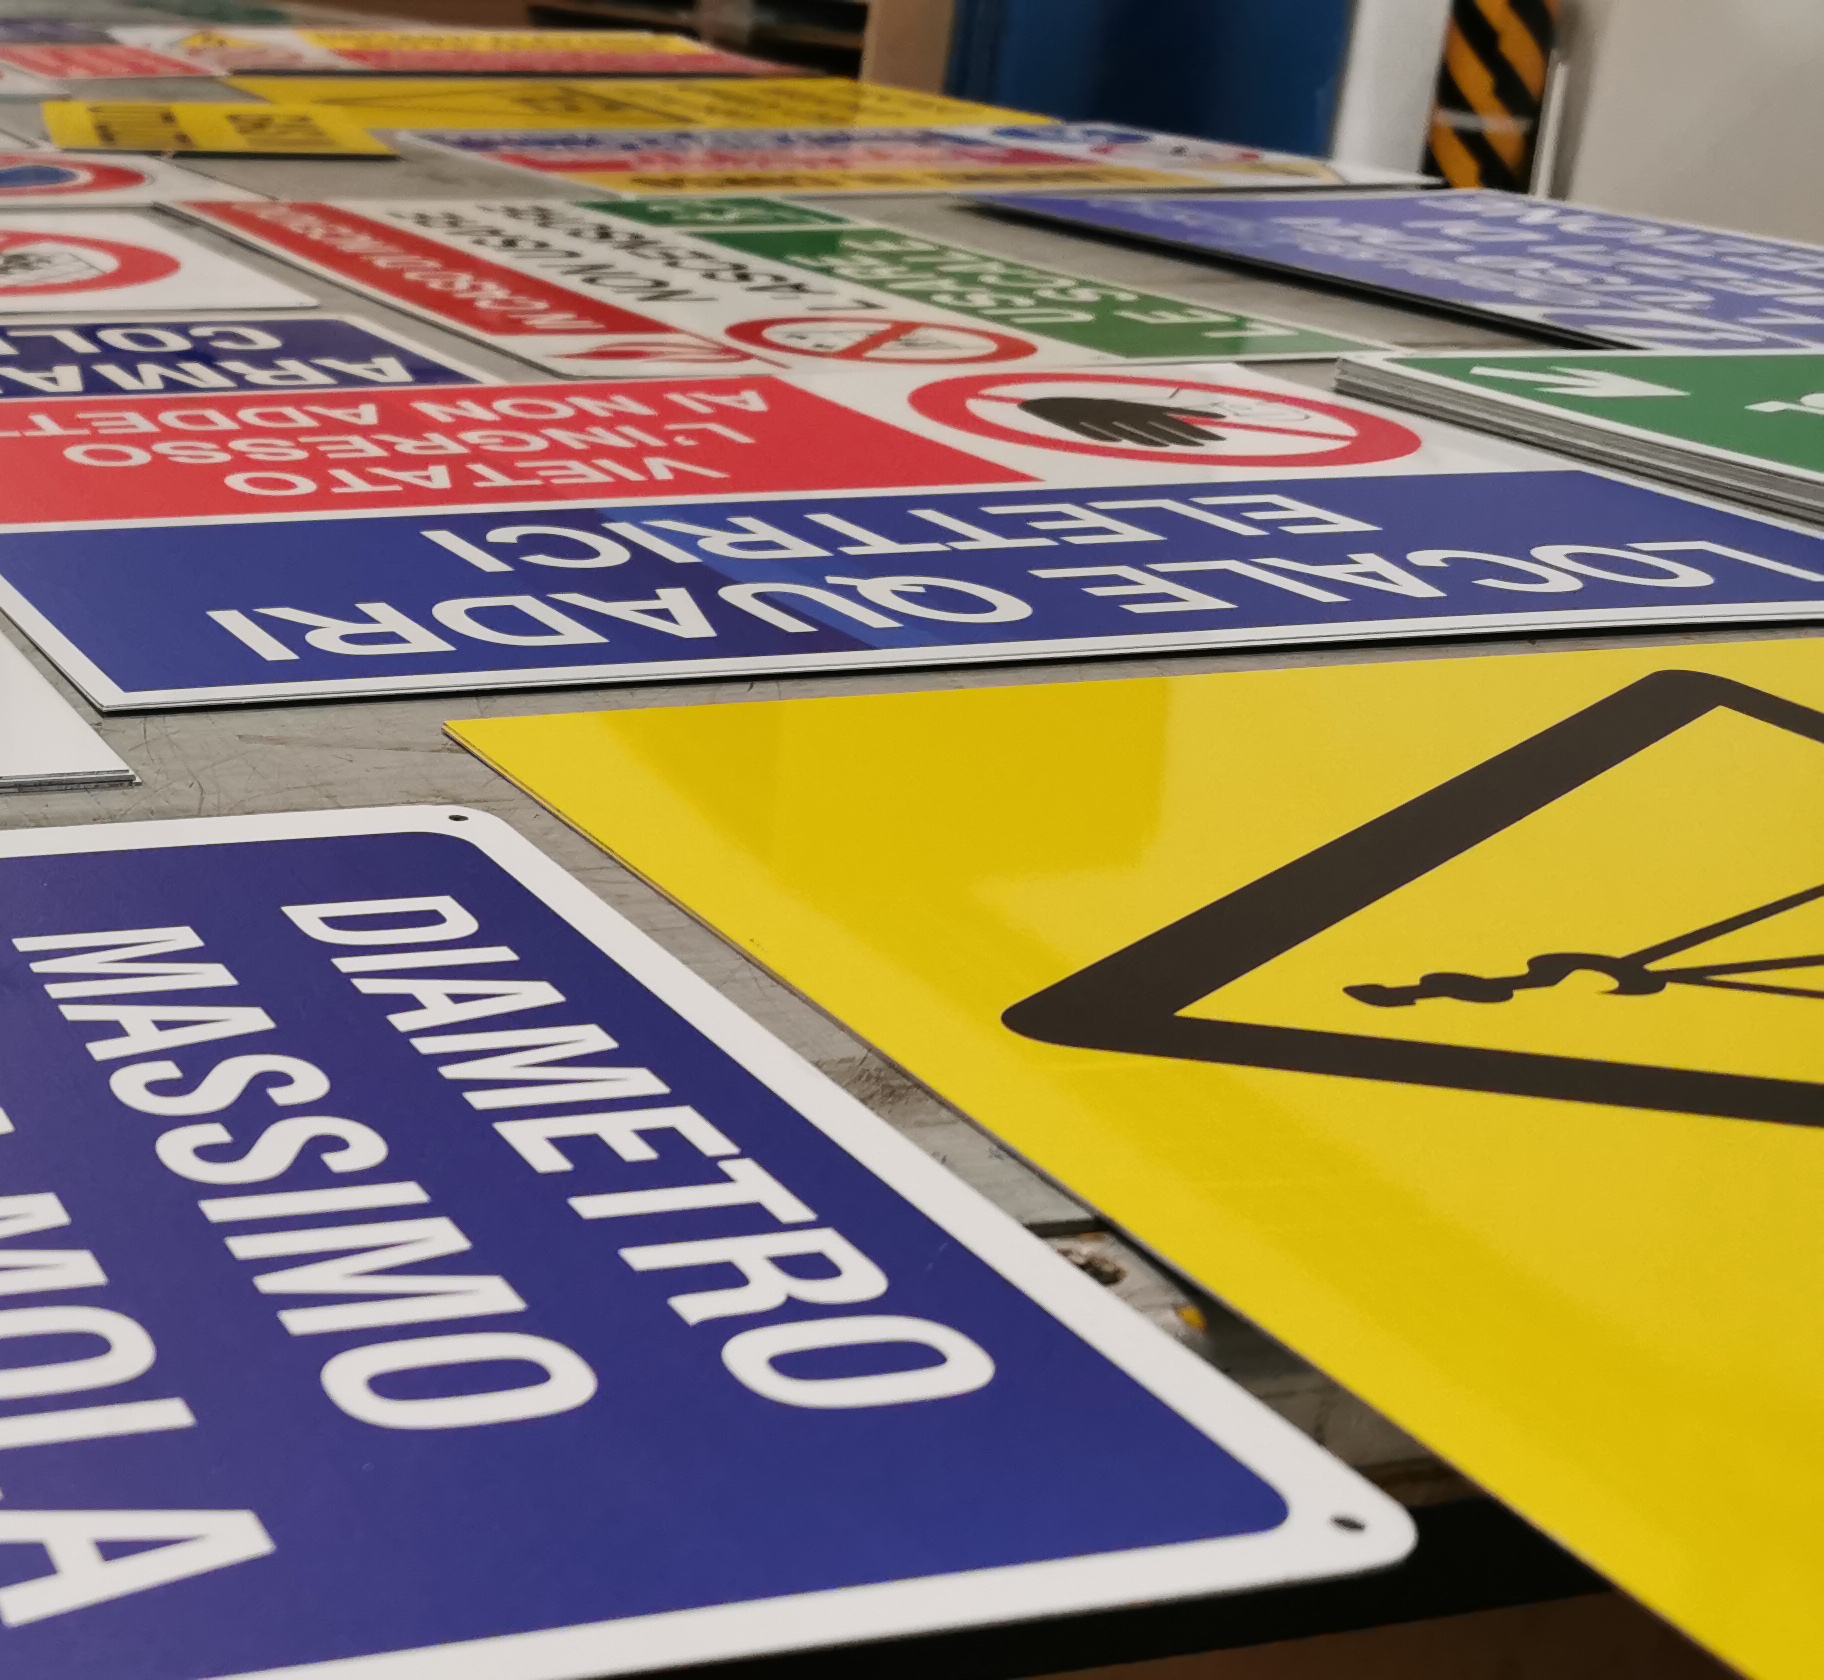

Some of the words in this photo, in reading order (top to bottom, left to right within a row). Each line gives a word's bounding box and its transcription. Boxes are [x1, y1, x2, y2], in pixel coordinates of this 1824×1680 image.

[385, 211, 584, 260] USARE
[539, 262, 719, 302] NON
[785, 255, 1095, 325] USARE
[838, 238, 1140, 303] SCALE
[1112, 307, 1300, 339] LE
[410, 394, 658, 423] NON
[664, 389, 768, 414] AI
[63, 422, 756, 467] L'INGRESSO
[224, 456, 731, 497] VIETATO
[420, 493, 1383, 574] ELETTRICI
[1029, 541, 1824, 614] LOCALE
[206, 573, 1033, 662] QUADRI
[12, 925, 598, 1431] MASSIMO
[280, 893, 995, 1410] DIAMETRO
